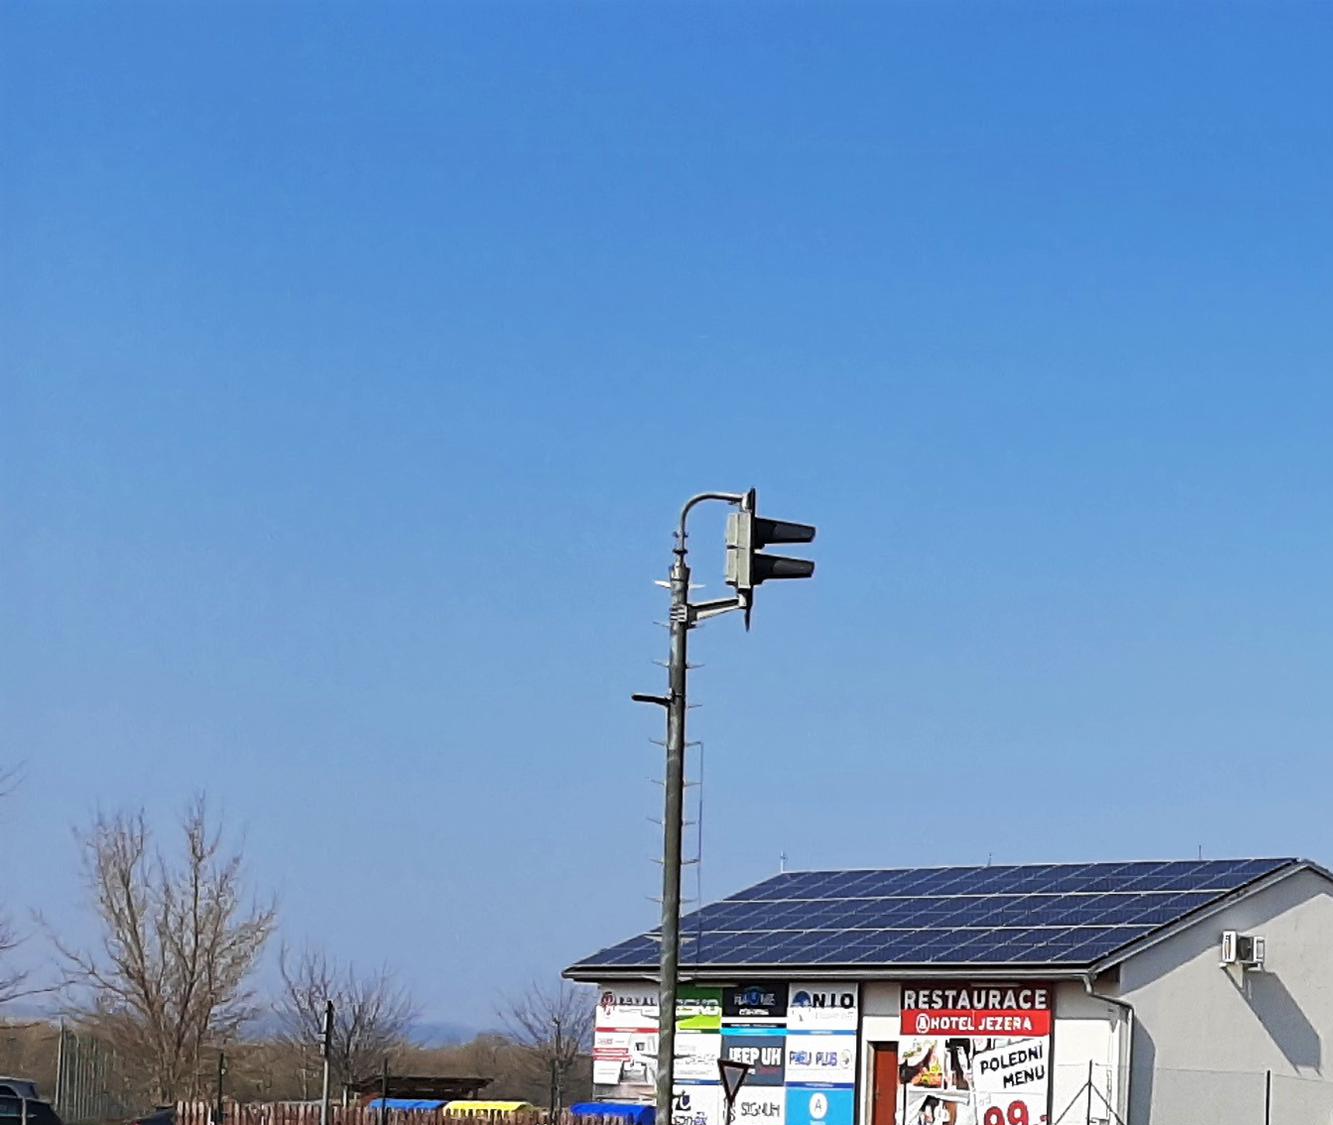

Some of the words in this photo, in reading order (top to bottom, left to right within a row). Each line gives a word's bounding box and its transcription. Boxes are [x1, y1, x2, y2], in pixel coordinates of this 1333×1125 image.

[904, 989, 1047, 1010] RESTAURACE
[930, 1016, 975, 1031] HOTEL
[978, 1016, 1033, 1031] JEZERA
[761, 1048, 782, 1065] UH
[980, 1041, 1043, 1074] POLEDNÍ
[1003, 1065, 1046, 1088] MENU
